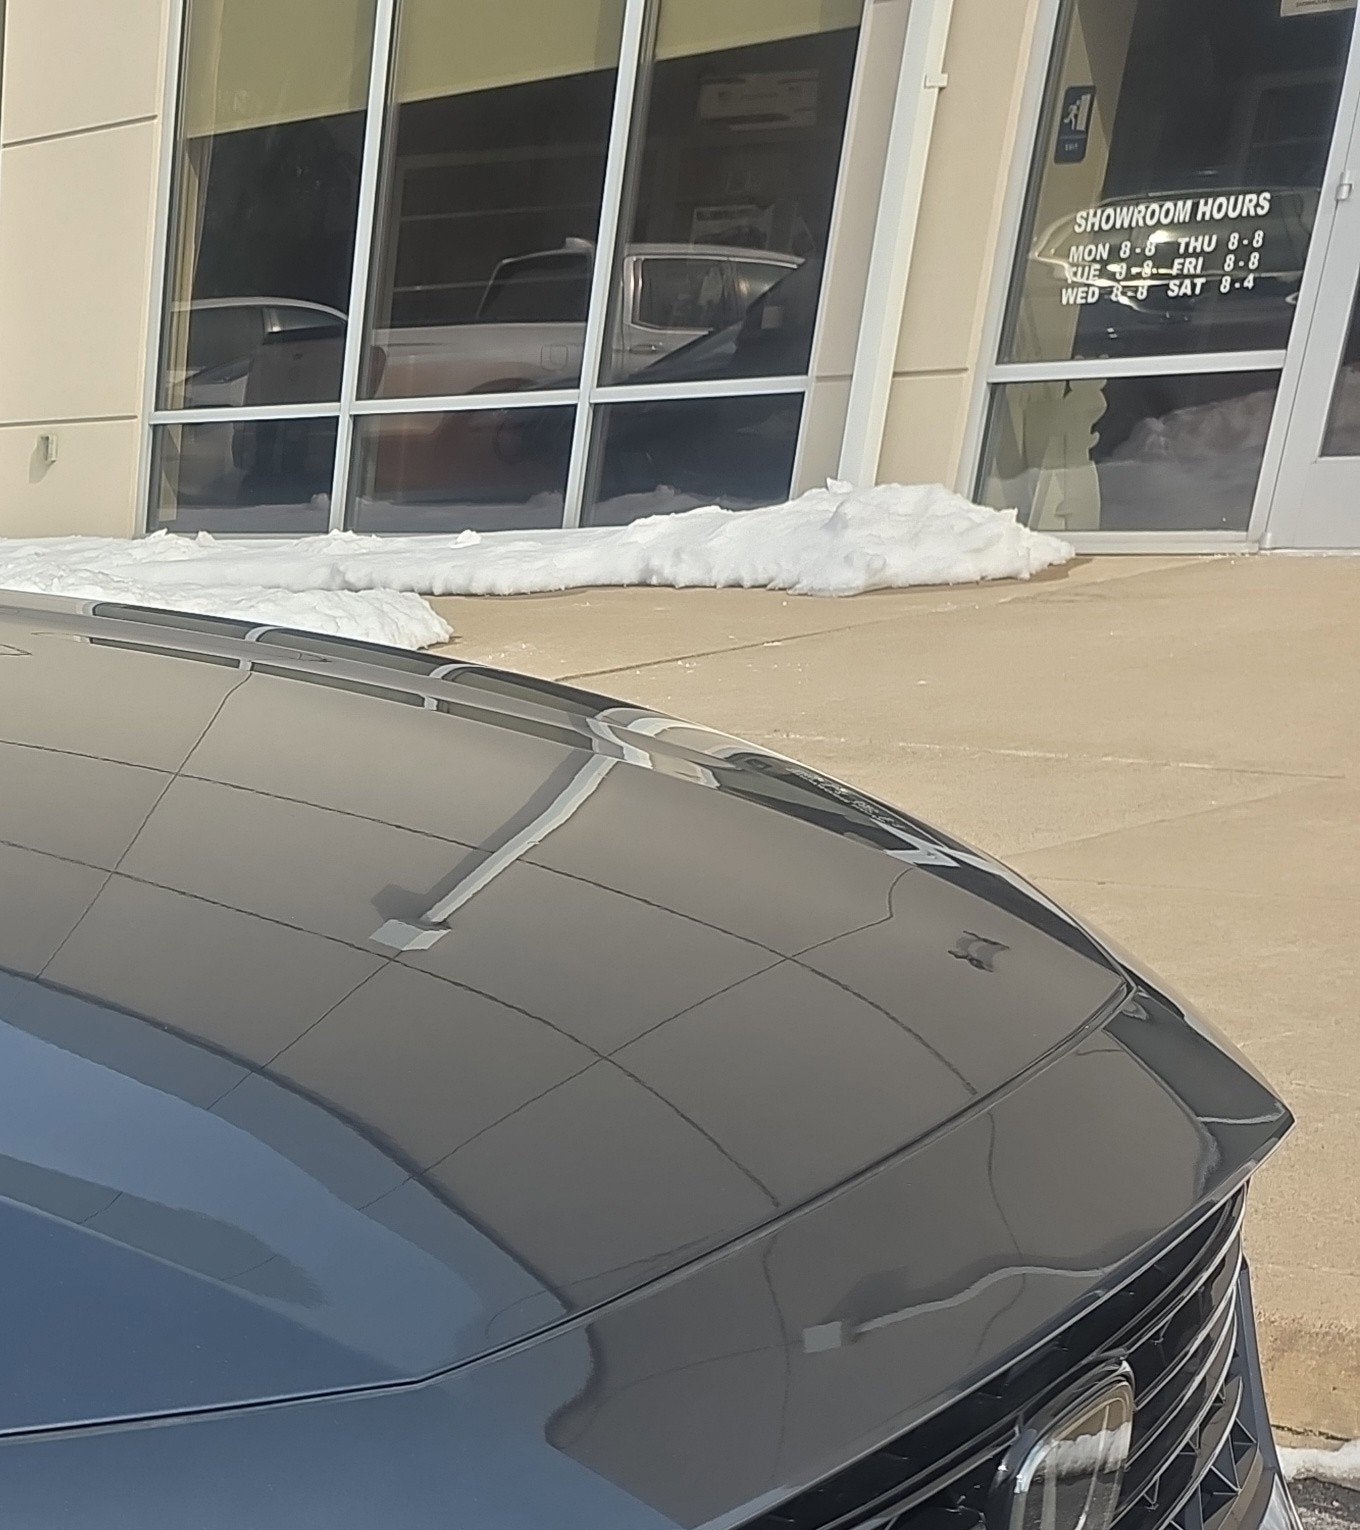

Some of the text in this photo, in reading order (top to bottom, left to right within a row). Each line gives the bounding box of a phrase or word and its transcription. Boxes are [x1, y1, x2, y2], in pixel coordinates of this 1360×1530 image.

[1074, 192, 1271, 233] SHOWROOM HOURS
[1069, 243, 1110, 264] MON
[1177, 235, 1218, 255] THU
[1172, 257, 1203, 276] FRI
[1061, 286, 1100, 306] WED
[1167, 277, 1207, 297] SAT
